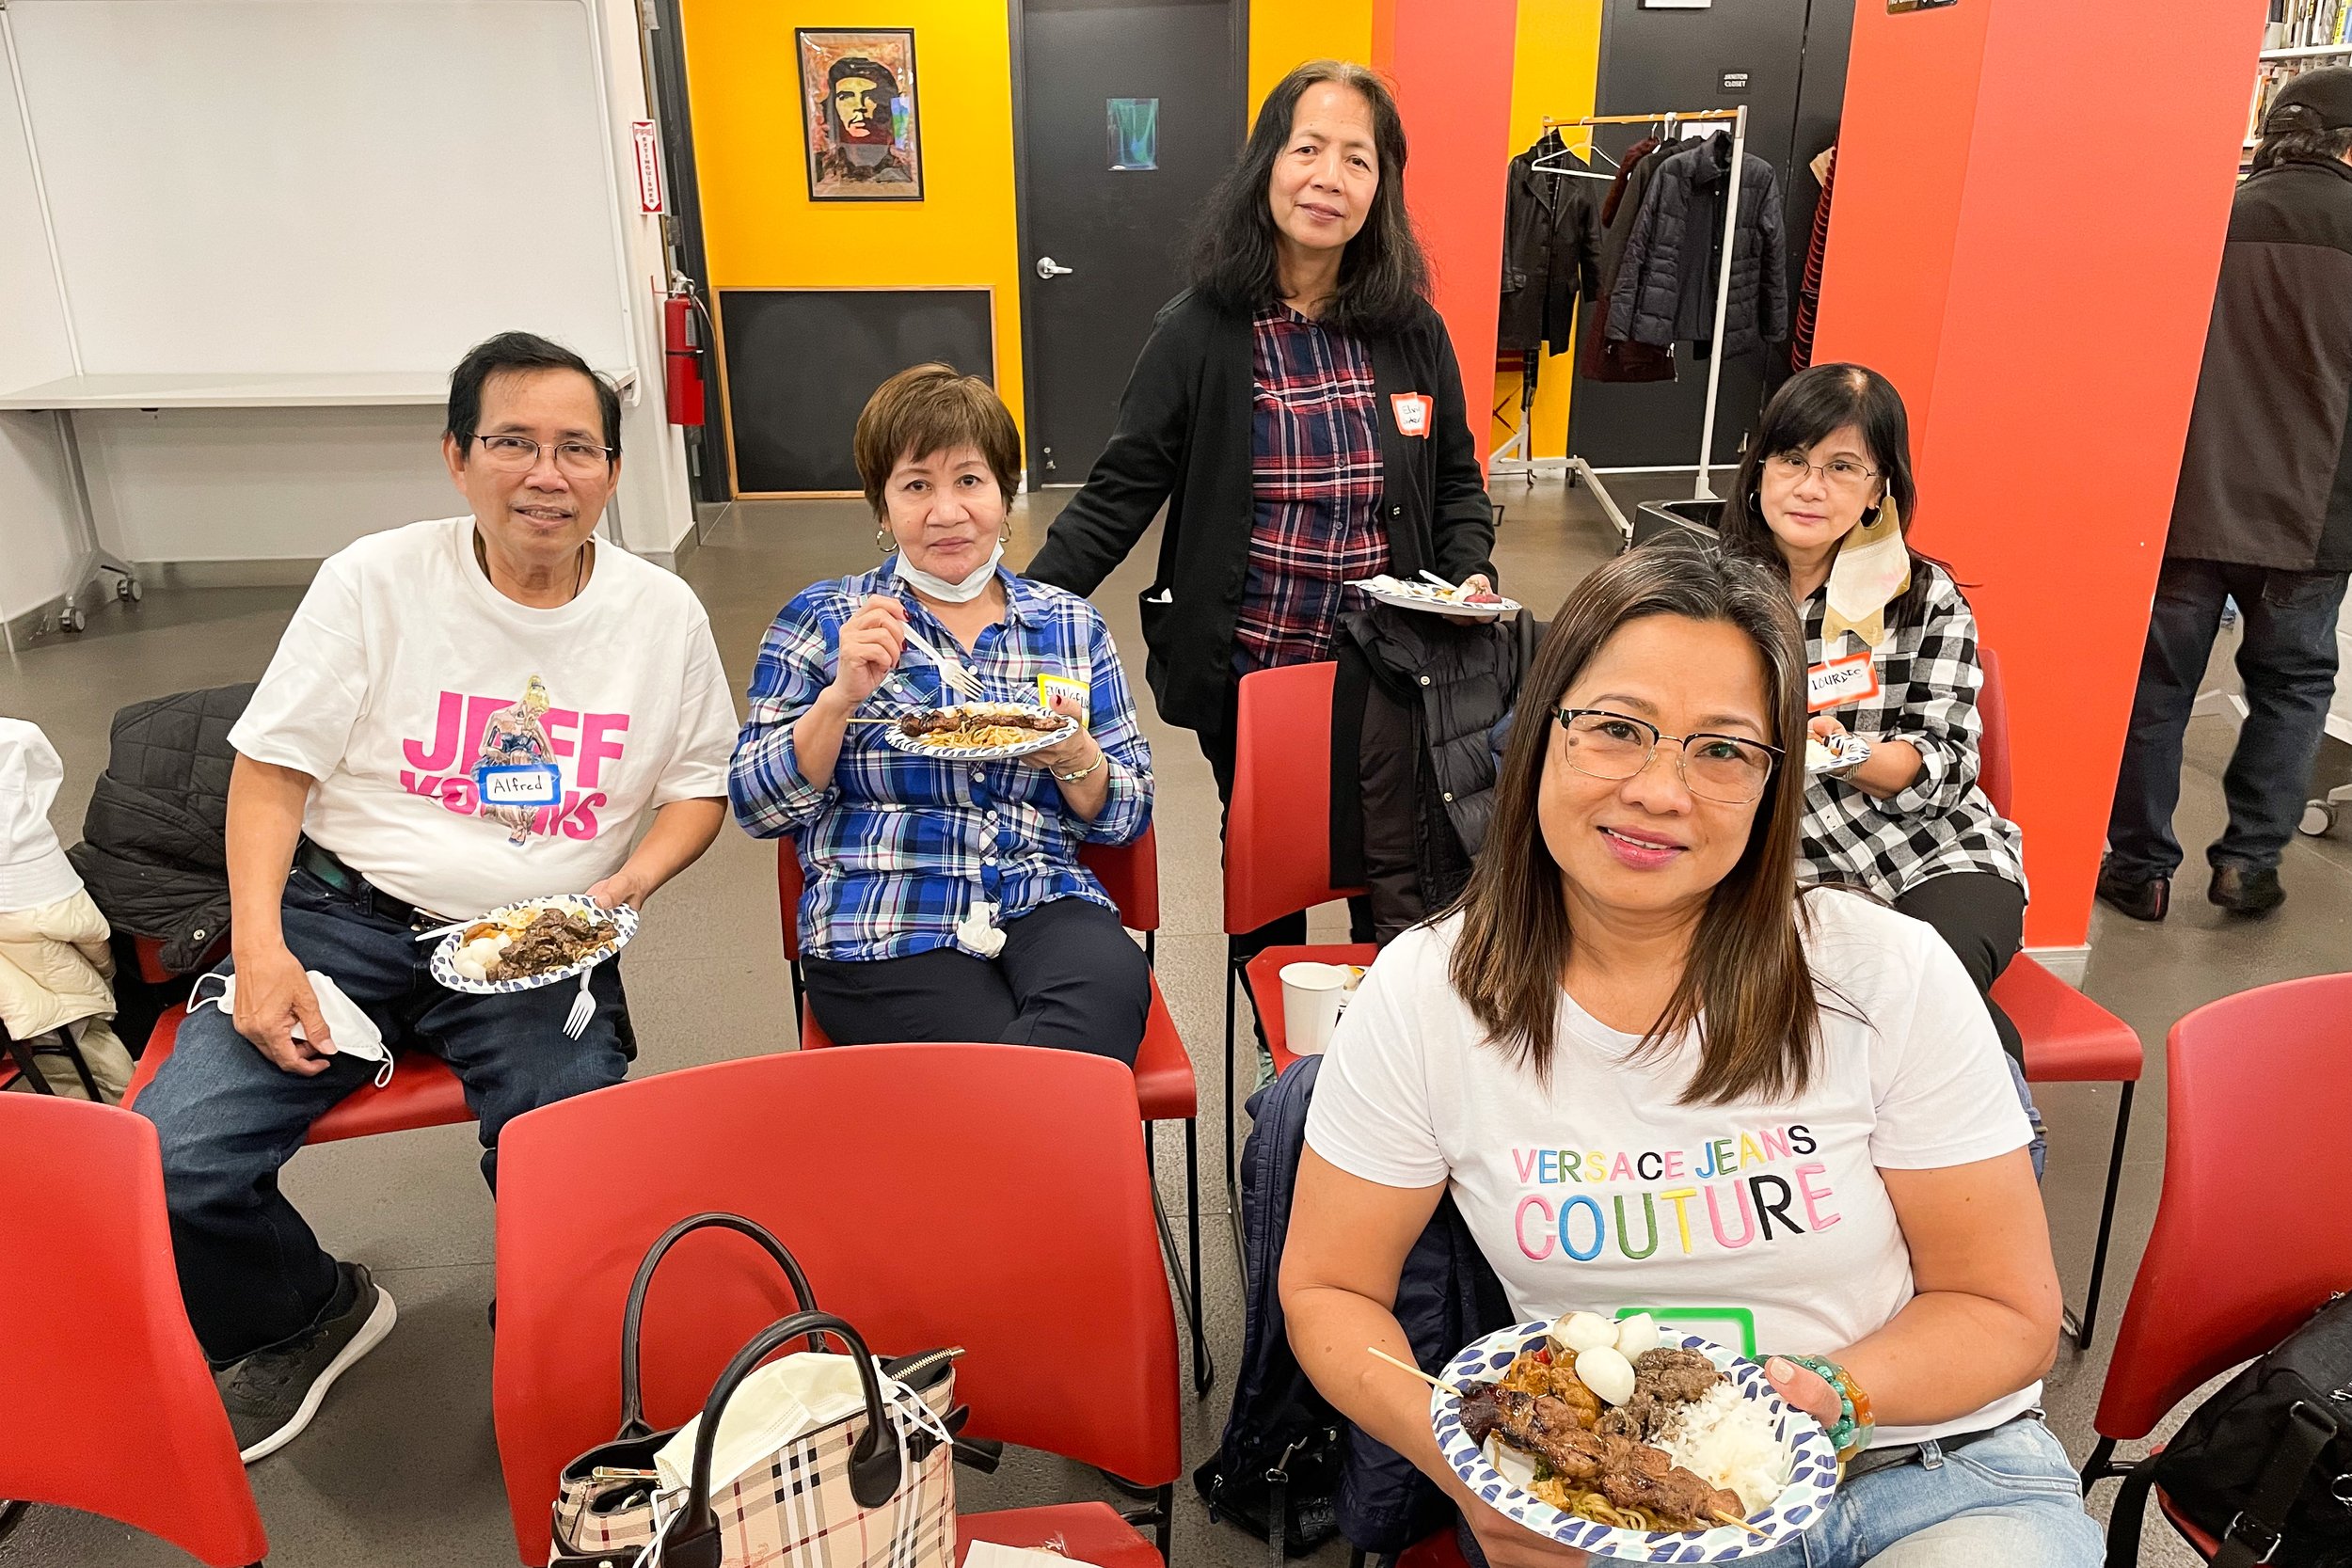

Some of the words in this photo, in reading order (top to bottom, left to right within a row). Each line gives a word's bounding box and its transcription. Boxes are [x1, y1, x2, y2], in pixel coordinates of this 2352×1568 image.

[400, 769, 607, 841] KONS
[493, 774, 543, 794] Alfred
[1512, 1148, 1685, 1184] VERSACE
[1695, 1125, 1818, 1180] JEANS
[1515, 1163, 1841, 1261] COUTURE
